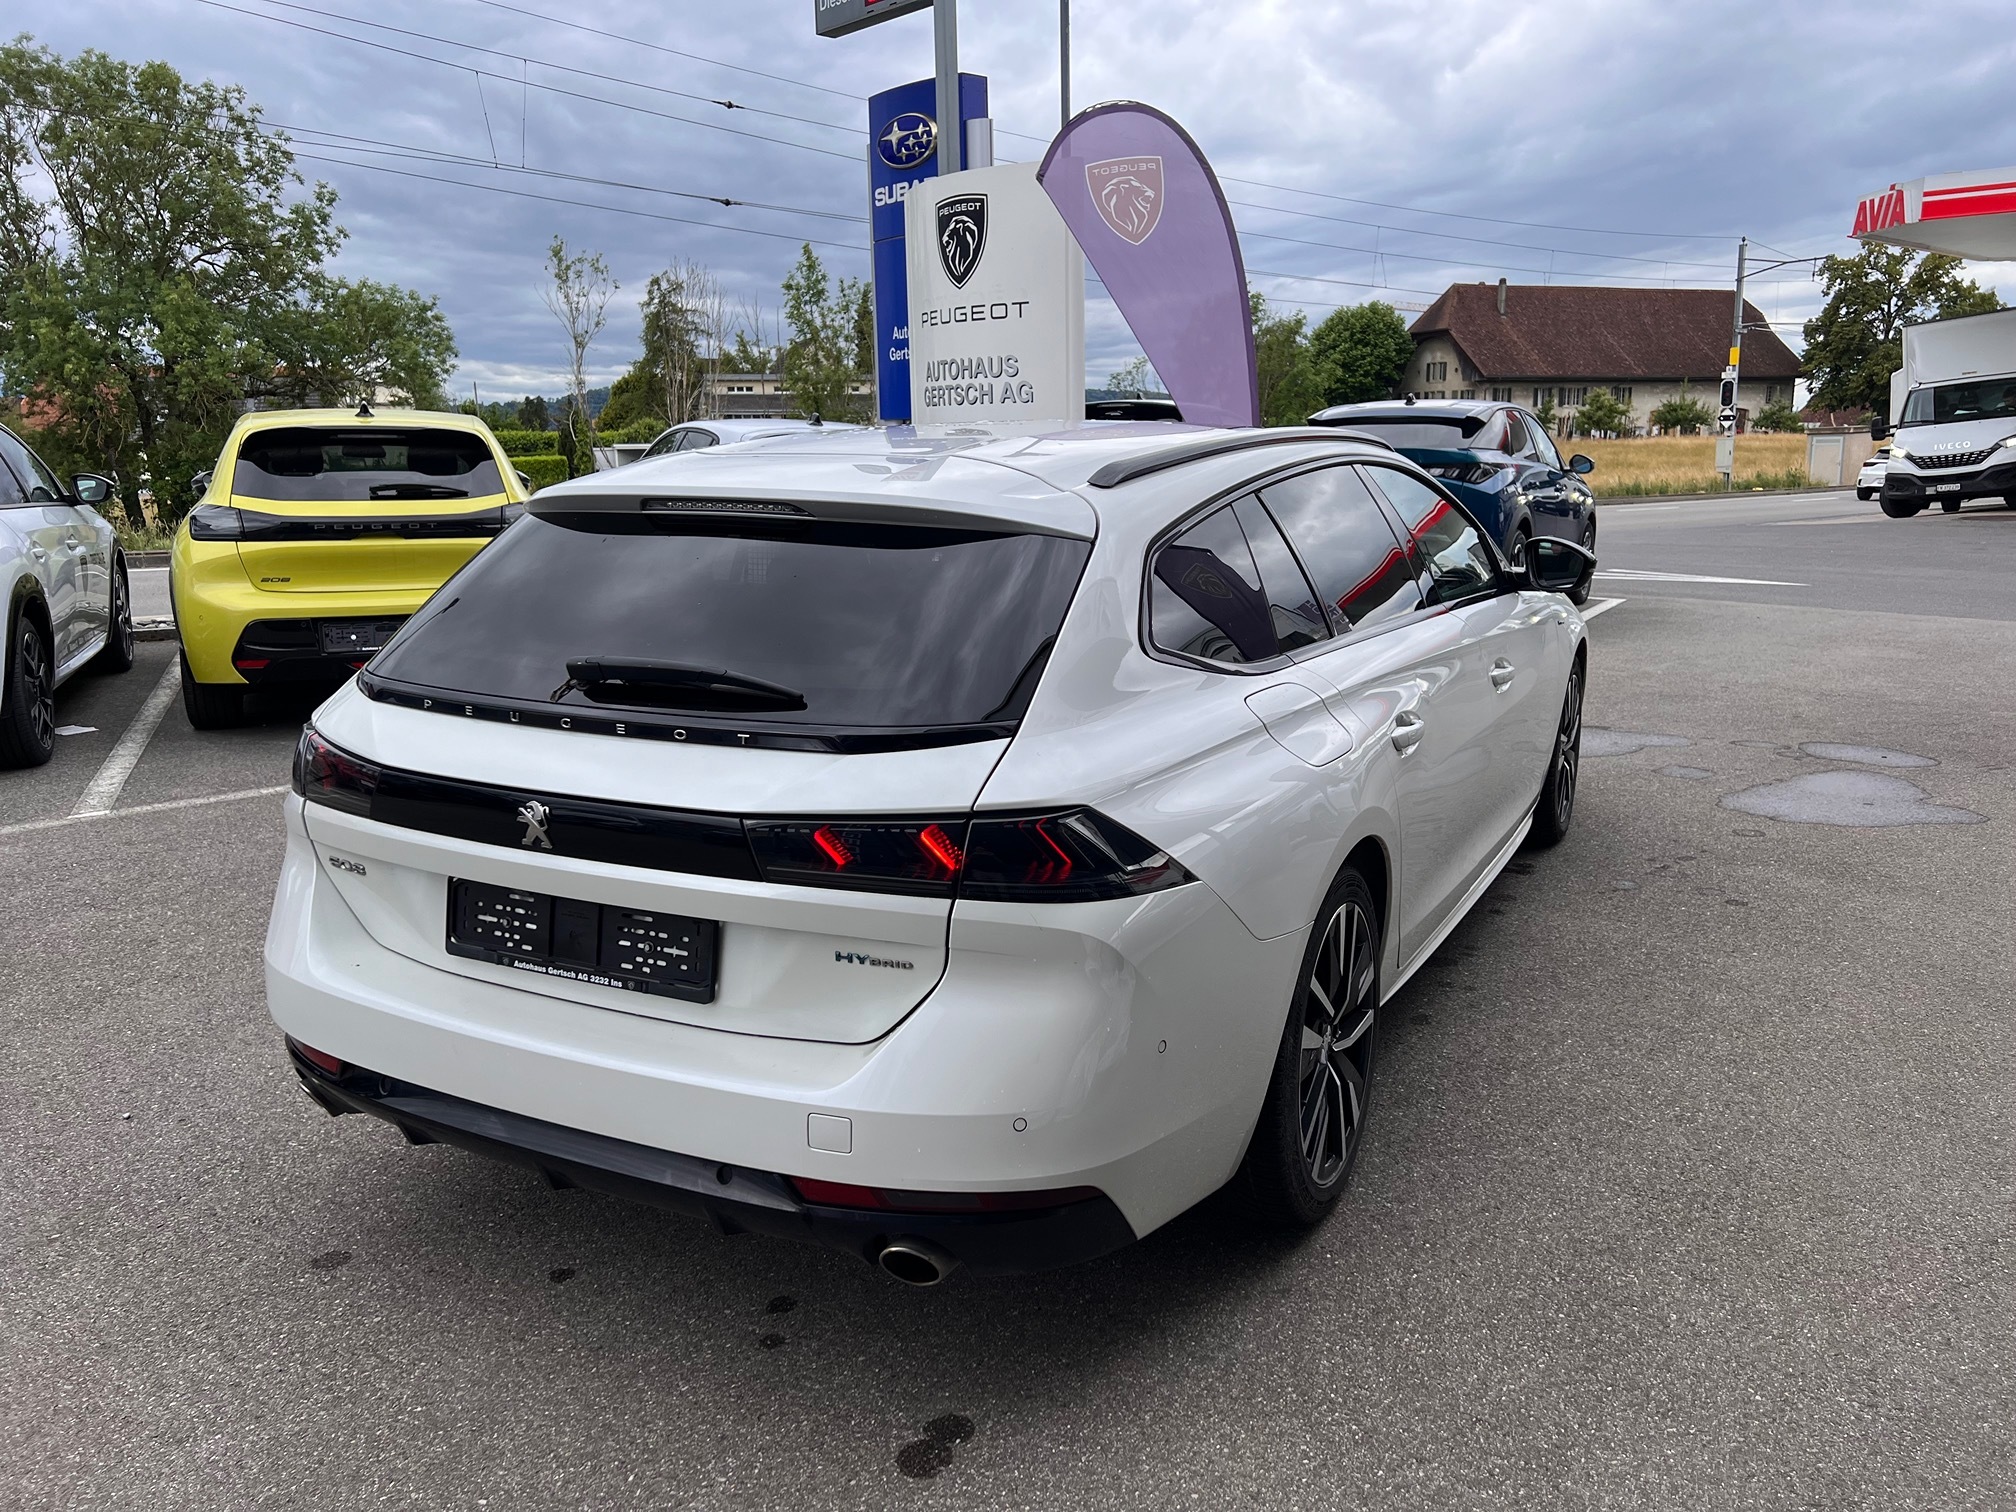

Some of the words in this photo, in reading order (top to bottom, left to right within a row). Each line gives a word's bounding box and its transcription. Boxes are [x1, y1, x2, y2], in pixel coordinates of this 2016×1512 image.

[939, 202, 982, 217] PEUGEOT
[1852, 183, 1906, 236] AVIA
[921, 301, 1030, 328] PEUGEOT
[892, 326, 911, 340] Aut
[926, 355, 1020, 383] AUTOHAUS
[924, 382, 995, 407] GERTSCH
[999, 381, 1034, 404] AG
[1934, 441, 1971, 450] IVECO
[314, 522, 438, 530] PEUGEOT
[423, 699, 750, 745] PEUGEOT
[835, 950, 914, 970] HYBRID
[513, 960, 547, 973] Autohaus
[547, 966, 576, 979] Gertsch
[577, 973, 589, 981] AG
[589, 975, 609, 985] 3232
[610, 979, 623, 988] Ins
